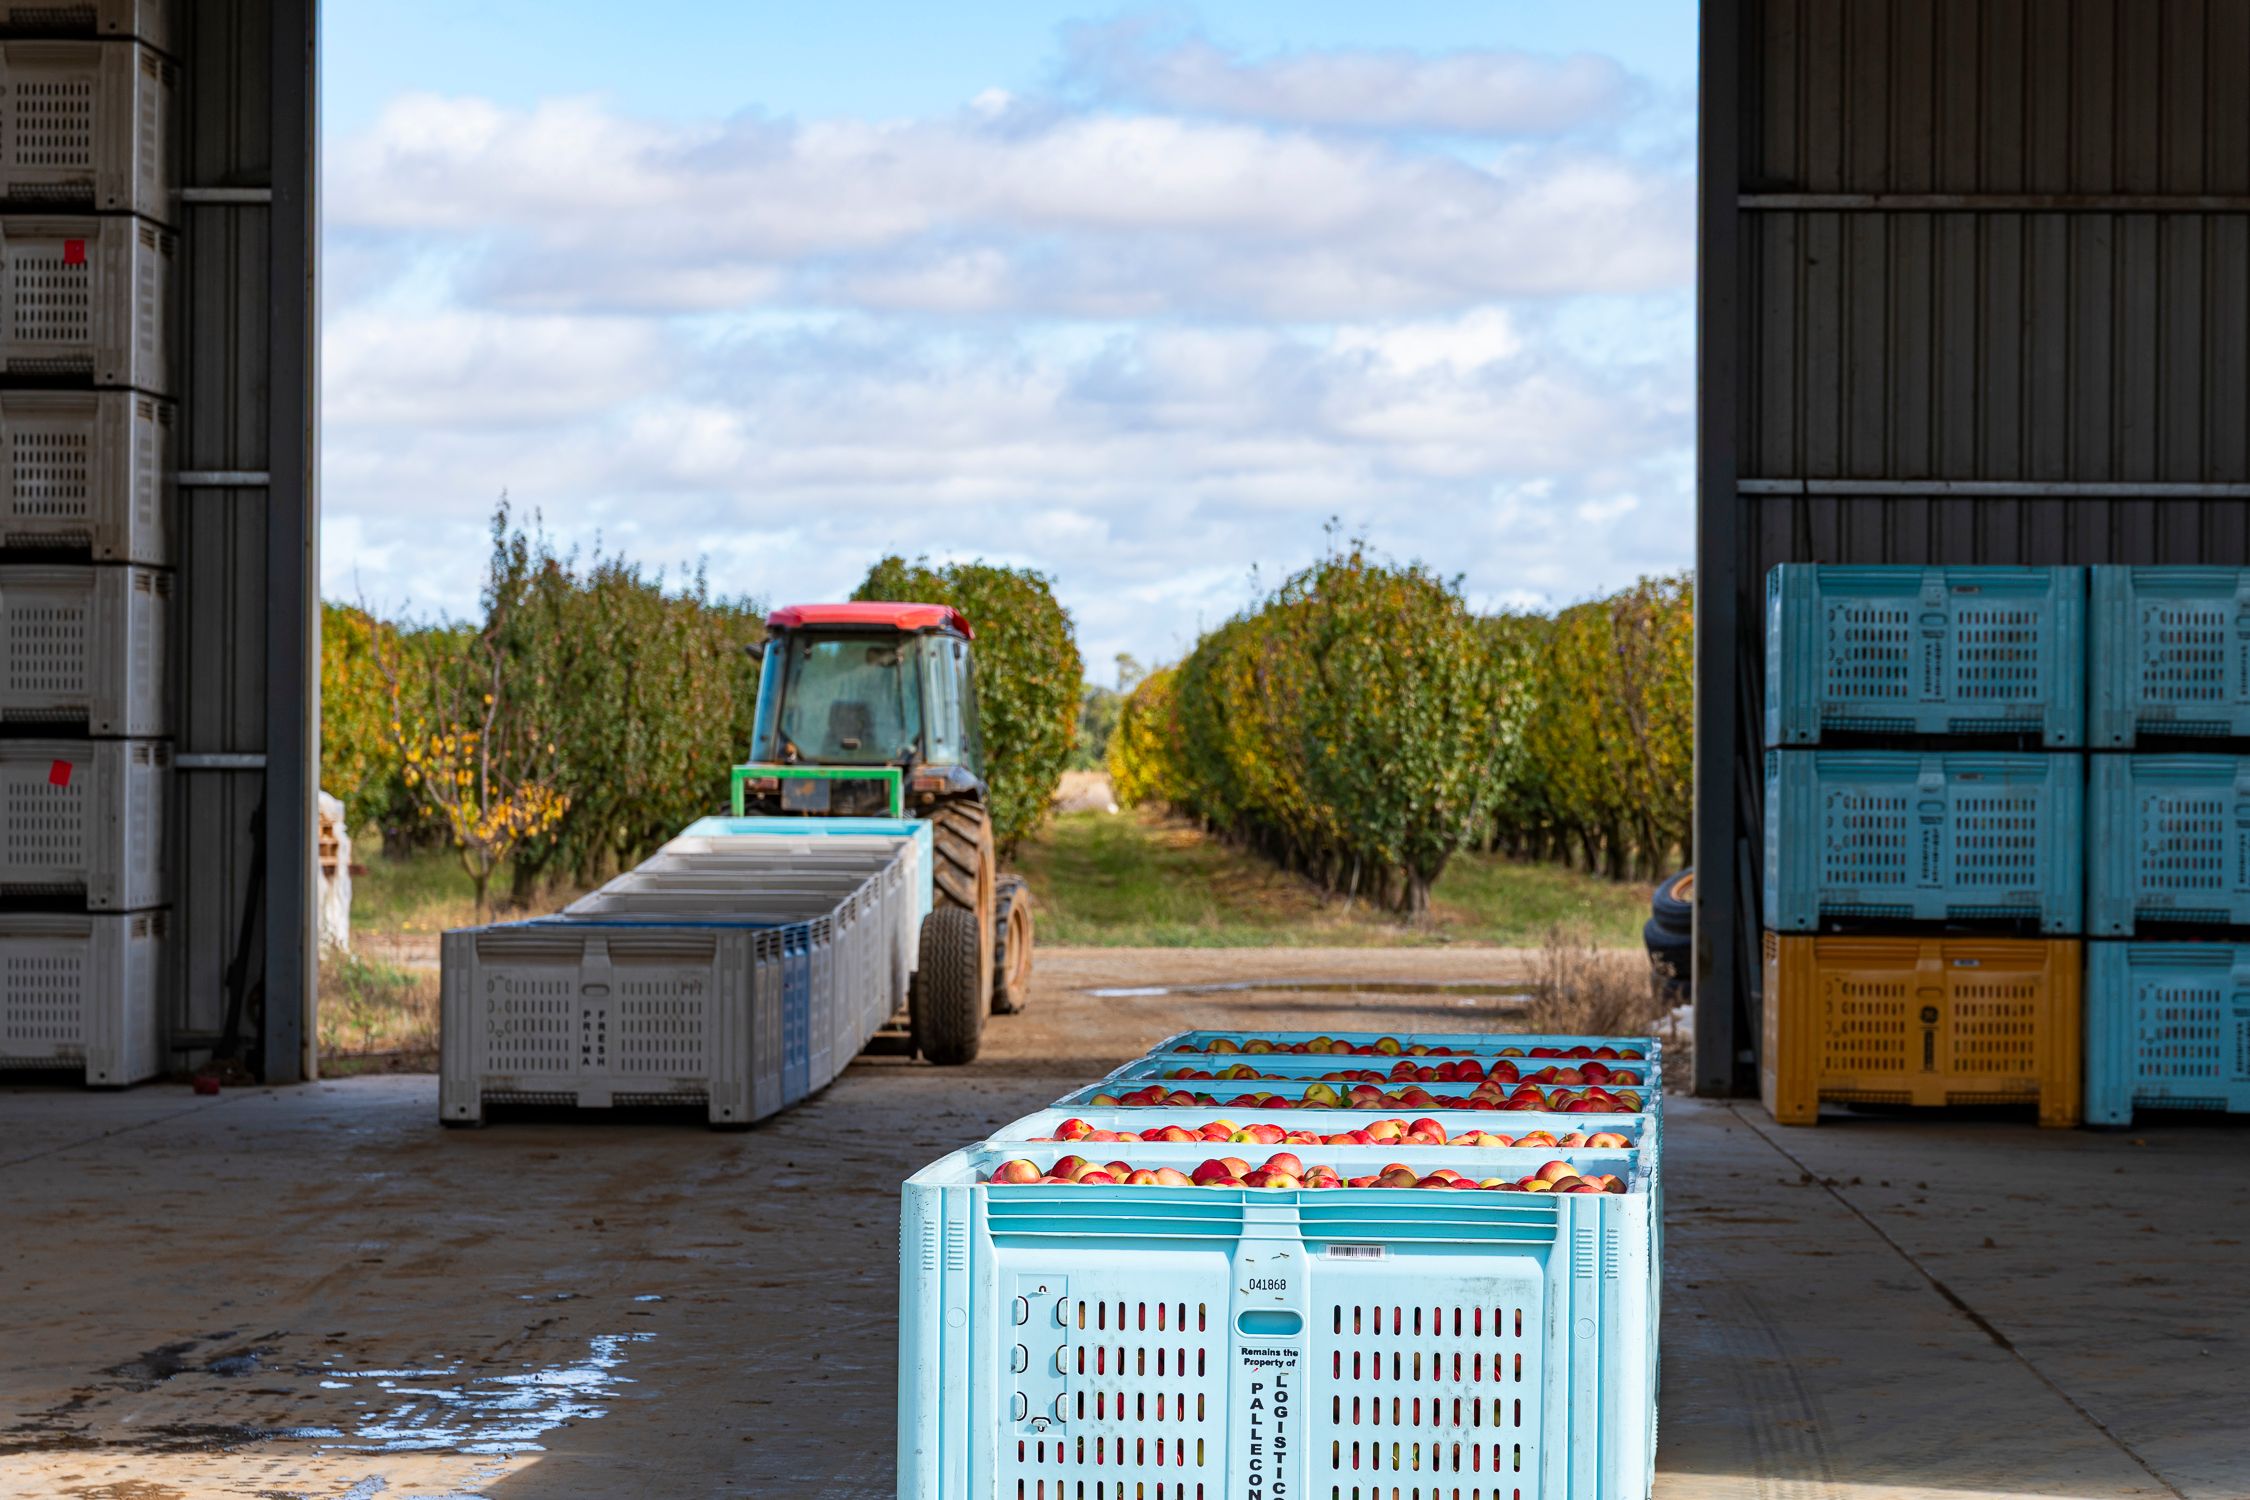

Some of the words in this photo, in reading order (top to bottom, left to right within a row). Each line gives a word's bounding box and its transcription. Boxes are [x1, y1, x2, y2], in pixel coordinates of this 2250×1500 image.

[582, 1009, 592, 1067] PRIMA
[597, 1009, 606, 1067] FRESH
[1249, 1278, 1287, 1290] 041868
[1241, 1347, 1281, 1356] Remains
[1283, 1349, 1299, 1357] the
[1244, 1357, 1284, 1368] Property
[1286, 1359, 1297, 1367] of
[1248, 1382, 1264, 1500] PALLECON
[1272, 1375, 1288, 1500] LOGISTIC
